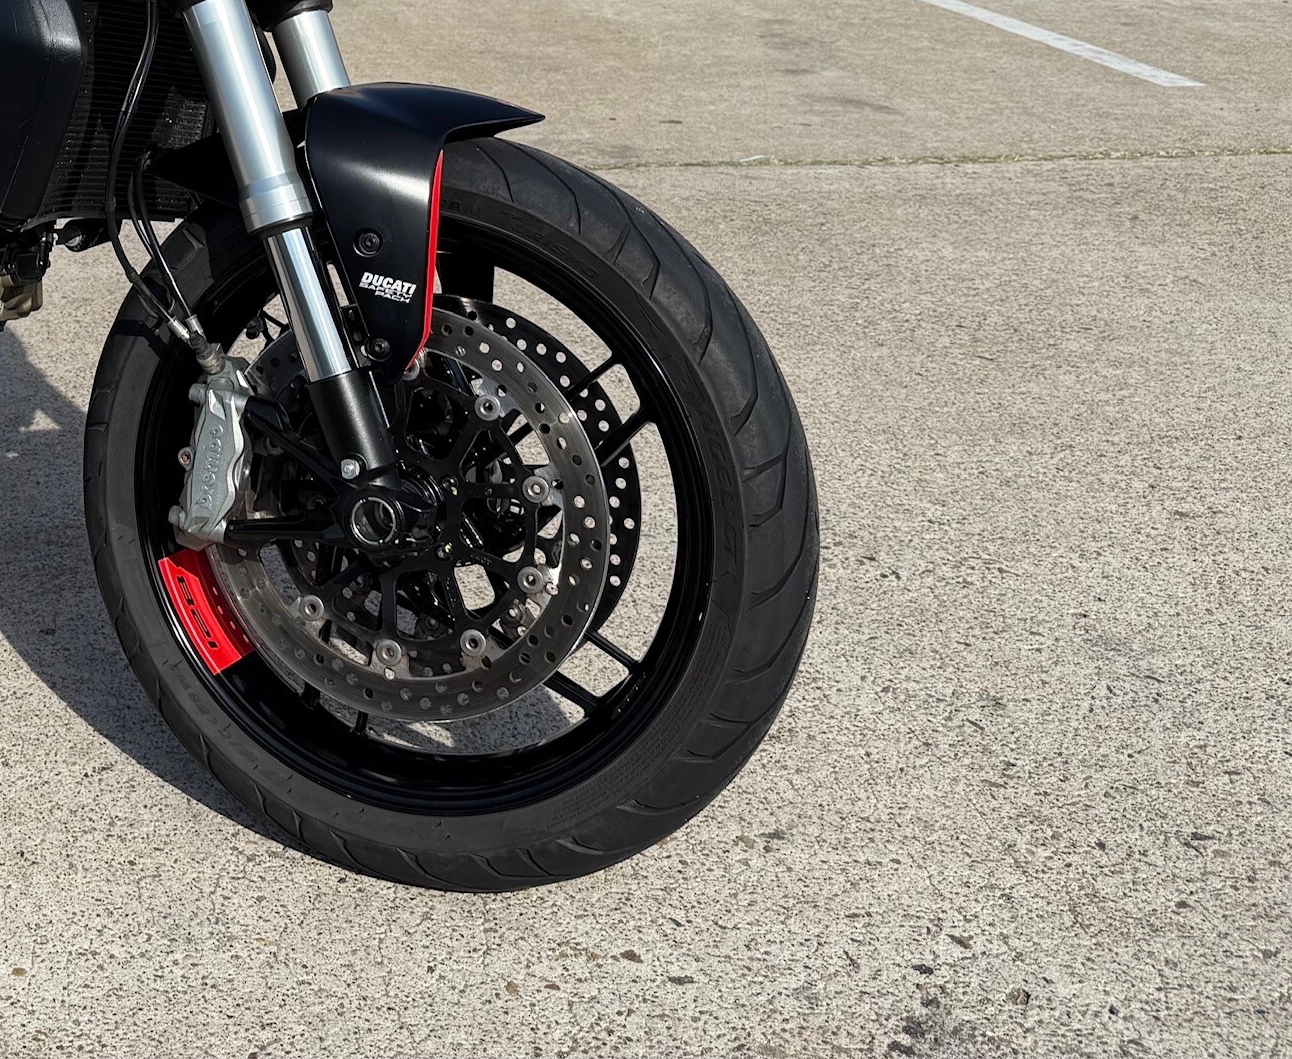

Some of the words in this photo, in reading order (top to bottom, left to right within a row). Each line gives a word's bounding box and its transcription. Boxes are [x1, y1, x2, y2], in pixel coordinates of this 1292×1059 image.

[358, 281, 413, 298] SAFETY
[360, 271, 417, 295] DUCATI
[374, 290, 411, 304] PACK
[194, 422, 226, 508] brembo
[176, 574, 220, 650] 821
